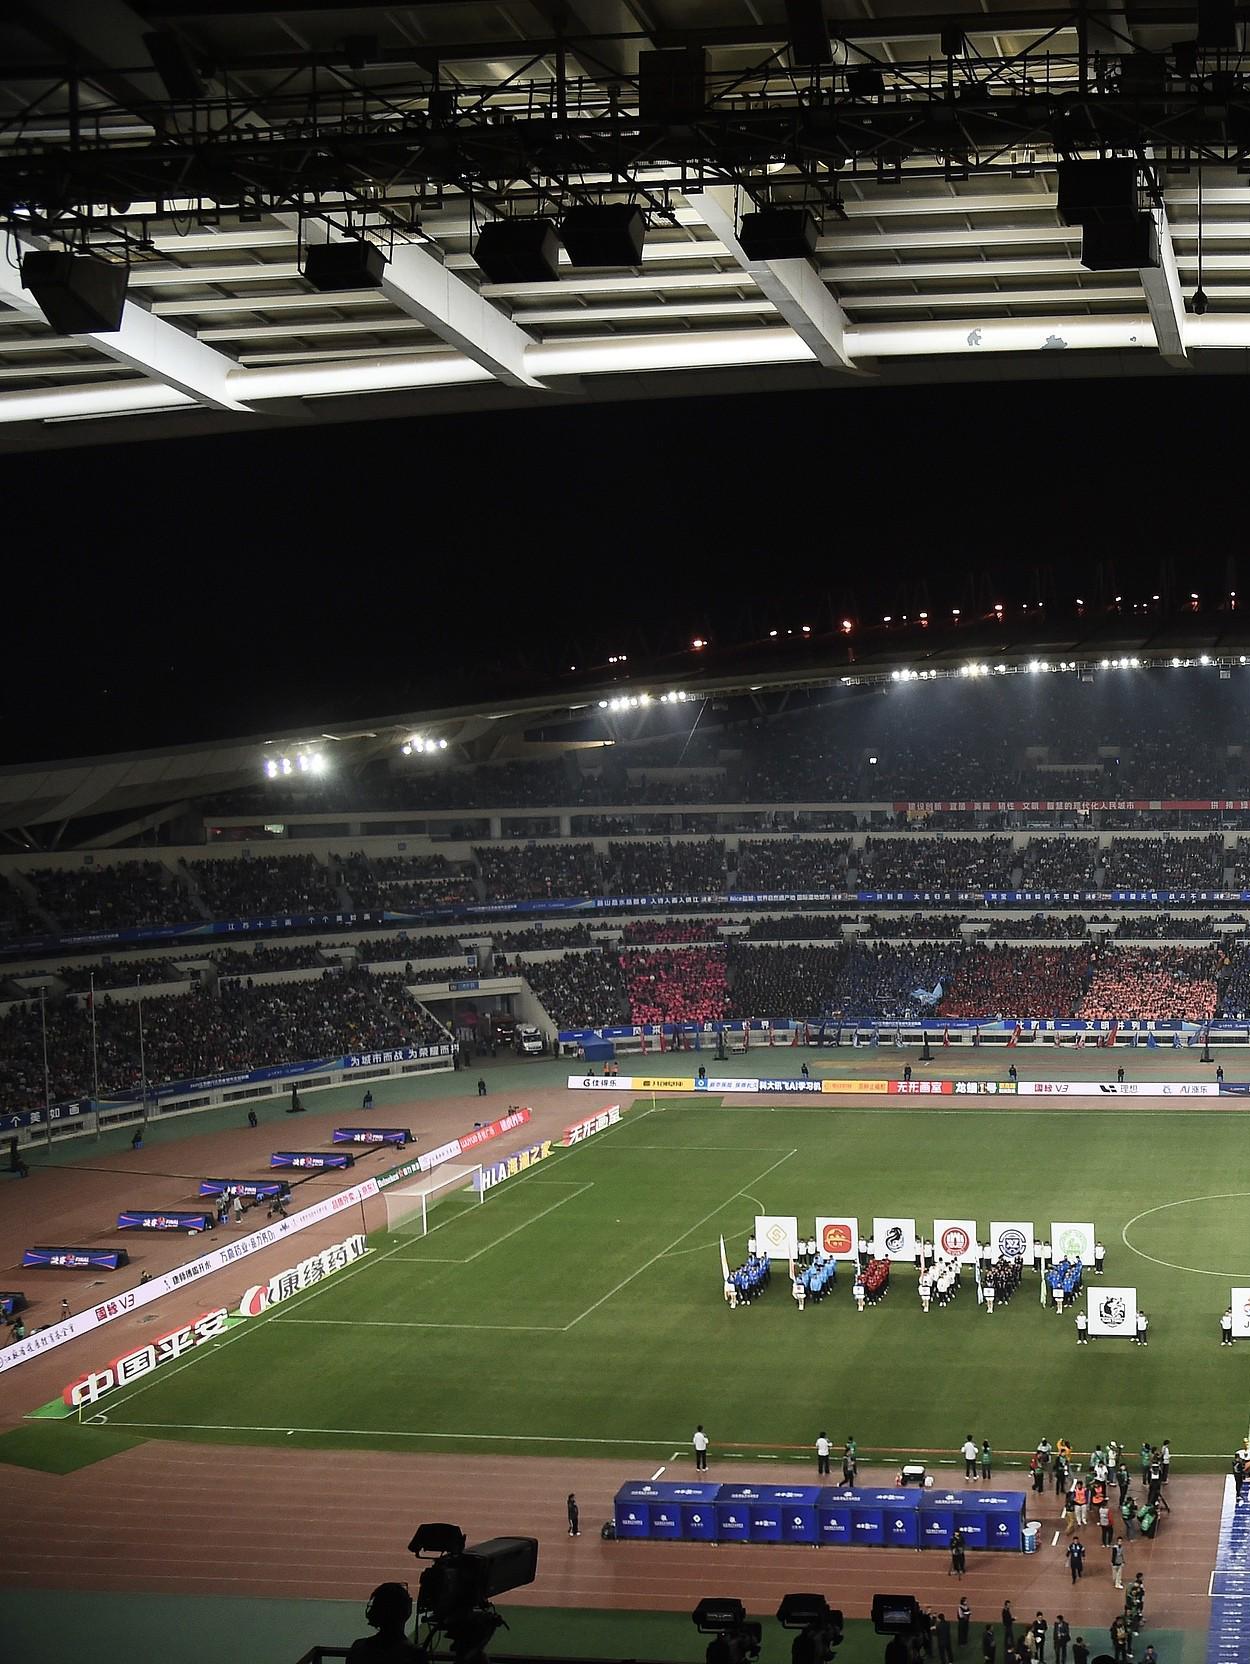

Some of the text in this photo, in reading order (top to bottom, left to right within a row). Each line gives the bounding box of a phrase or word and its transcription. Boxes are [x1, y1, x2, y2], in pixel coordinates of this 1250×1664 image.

[351, 1050, 404, 1067] 为城市而战
[897, 1081, 943, 1093] 无形画室
[1055, 1084, 1069, 1093] V3
[567, 1105, 622, 1146] 无形画室
[271, 1234, 368, 1303] 康缘药业
[94, 1293, 135, 1323] 国缘 V3
[70, 1306, 231, 1407] 中国平安
